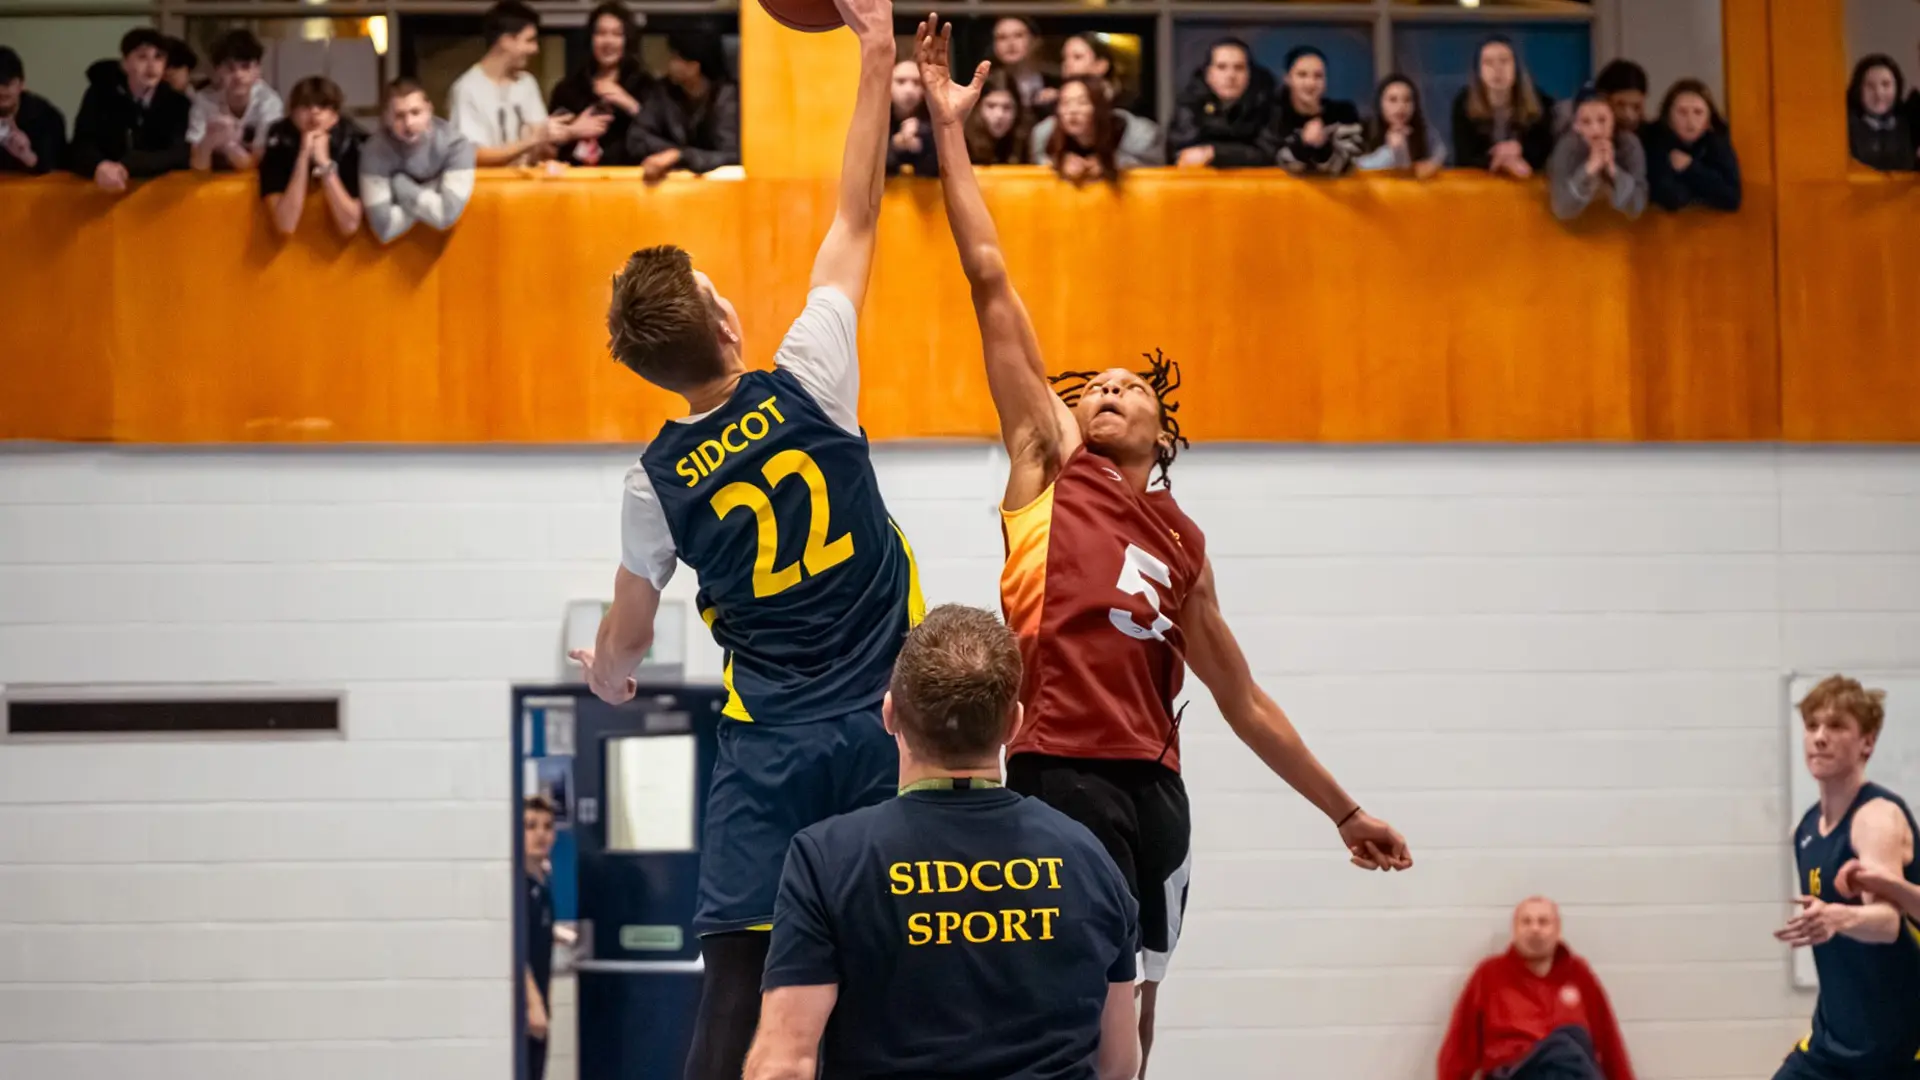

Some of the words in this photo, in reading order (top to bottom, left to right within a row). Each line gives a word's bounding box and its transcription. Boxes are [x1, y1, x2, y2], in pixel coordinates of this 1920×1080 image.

[675, 396, 786, 488] SIDCOT
[709, 449, 855, 599] 22
[1109, 543, 1173, 641] 5
[889, 857, 1063, 895] SIDCOT
[907, 907, 1060, 946] SPORT
